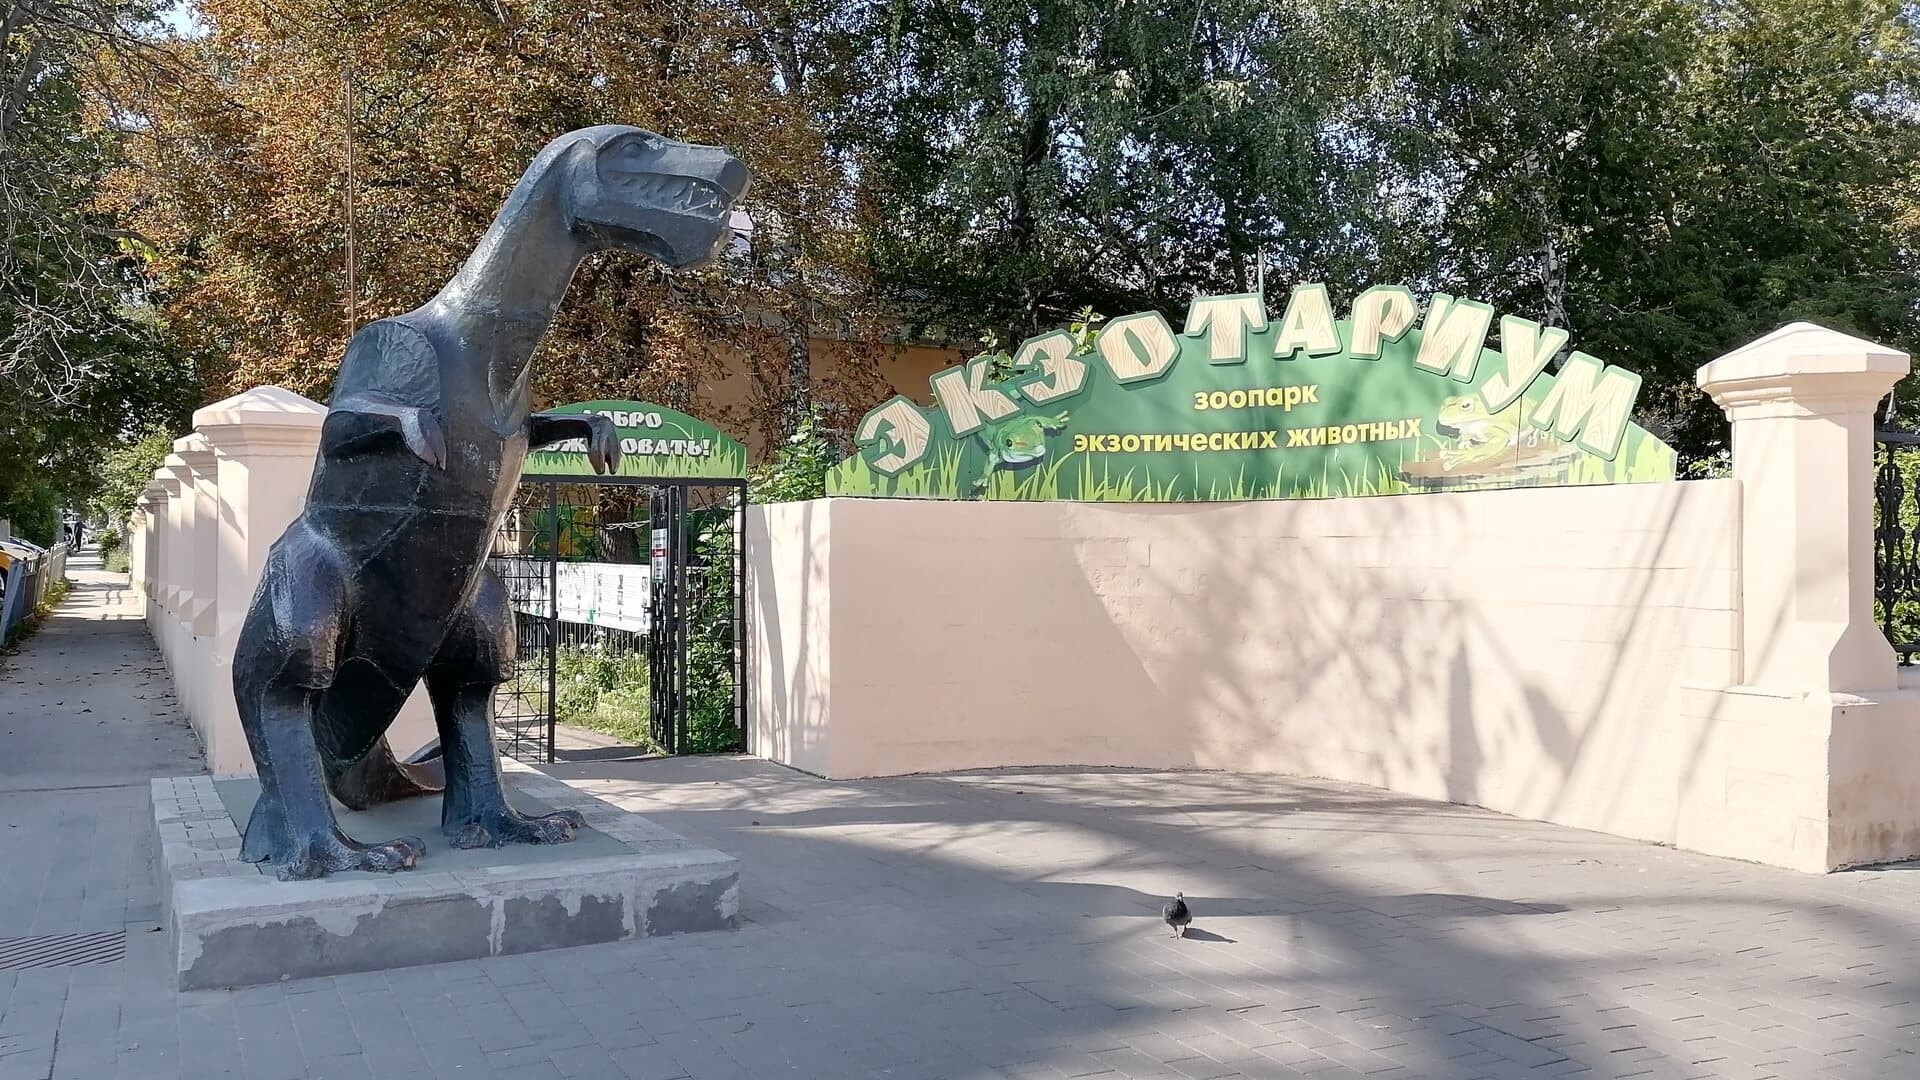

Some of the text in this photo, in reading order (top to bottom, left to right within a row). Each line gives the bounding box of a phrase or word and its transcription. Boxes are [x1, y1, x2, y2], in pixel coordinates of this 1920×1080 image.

[855, 284, 1641, 476] ЭКЗОТАРИУМ
[1194, 385, 1319, 412] зоопарк
[583, 409, 663, 428] БРО
[540, 437, 711, 456] ЖОВАТЬ!
[1074, 418, 1422, 452] экзотических животных
